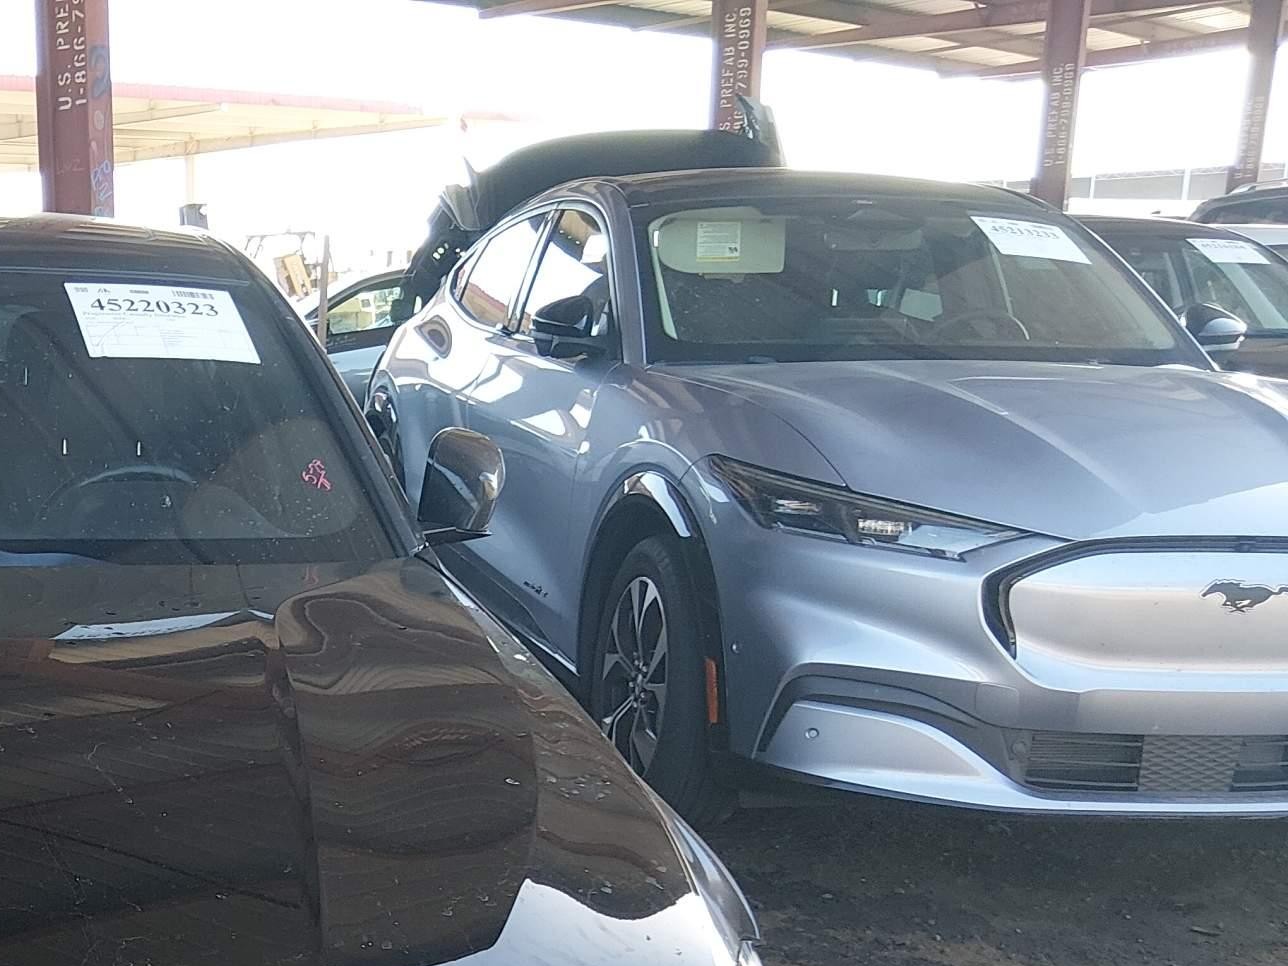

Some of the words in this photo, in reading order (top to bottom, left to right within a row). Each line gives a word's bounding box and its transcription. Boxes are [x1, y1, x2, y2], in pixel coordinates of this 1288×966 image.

[56, 0, 70, 50] PRE
[57, 64, 72, 111] U.S.
[720, 46, 736, 108] PREFAB
[90, 298, 219, 317] 45220323
